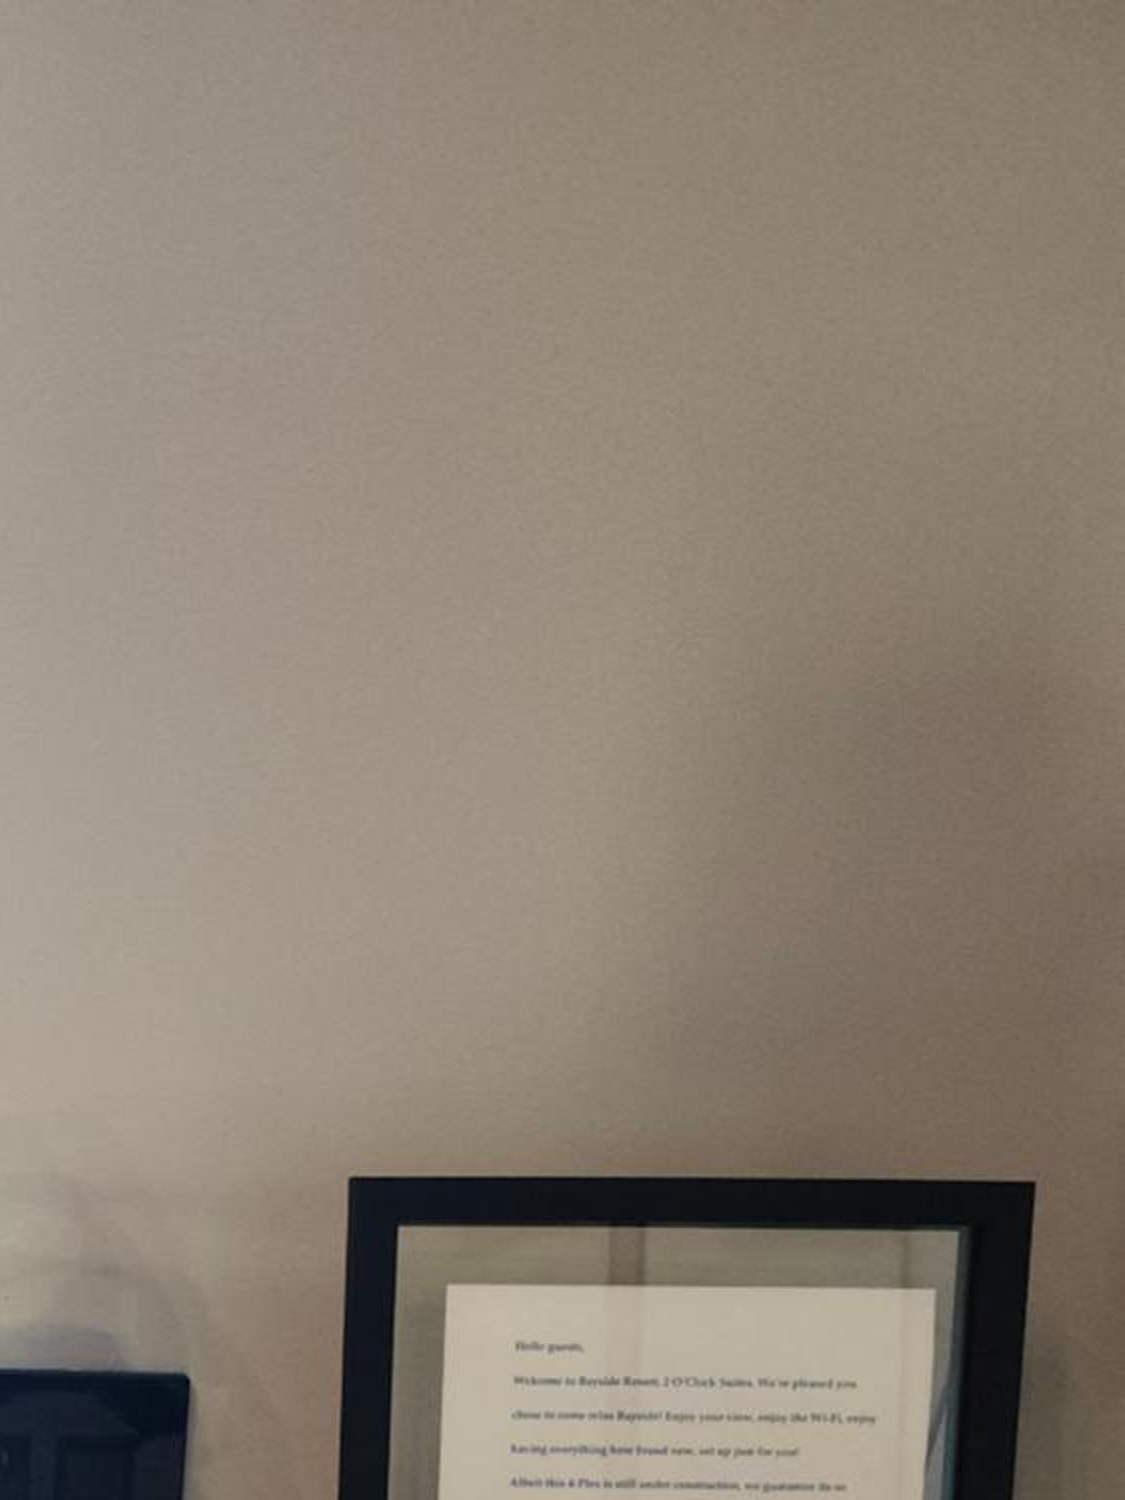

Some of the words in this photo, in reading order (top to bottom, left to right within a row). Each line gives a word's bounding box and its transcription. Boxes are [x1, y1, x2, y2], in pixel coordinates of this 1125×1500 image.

[513, 1376, 561, 1386] Welcome
[565, 1377, 575, 1386] to
[579, 1376, 620, 1389] Bayside
[792, 1378, 833, 1391] pleased
[836, 1380, 857, 1391] you
[790, 1412, 807, 1422] the
[550, 1445, 607, 1458] everything
